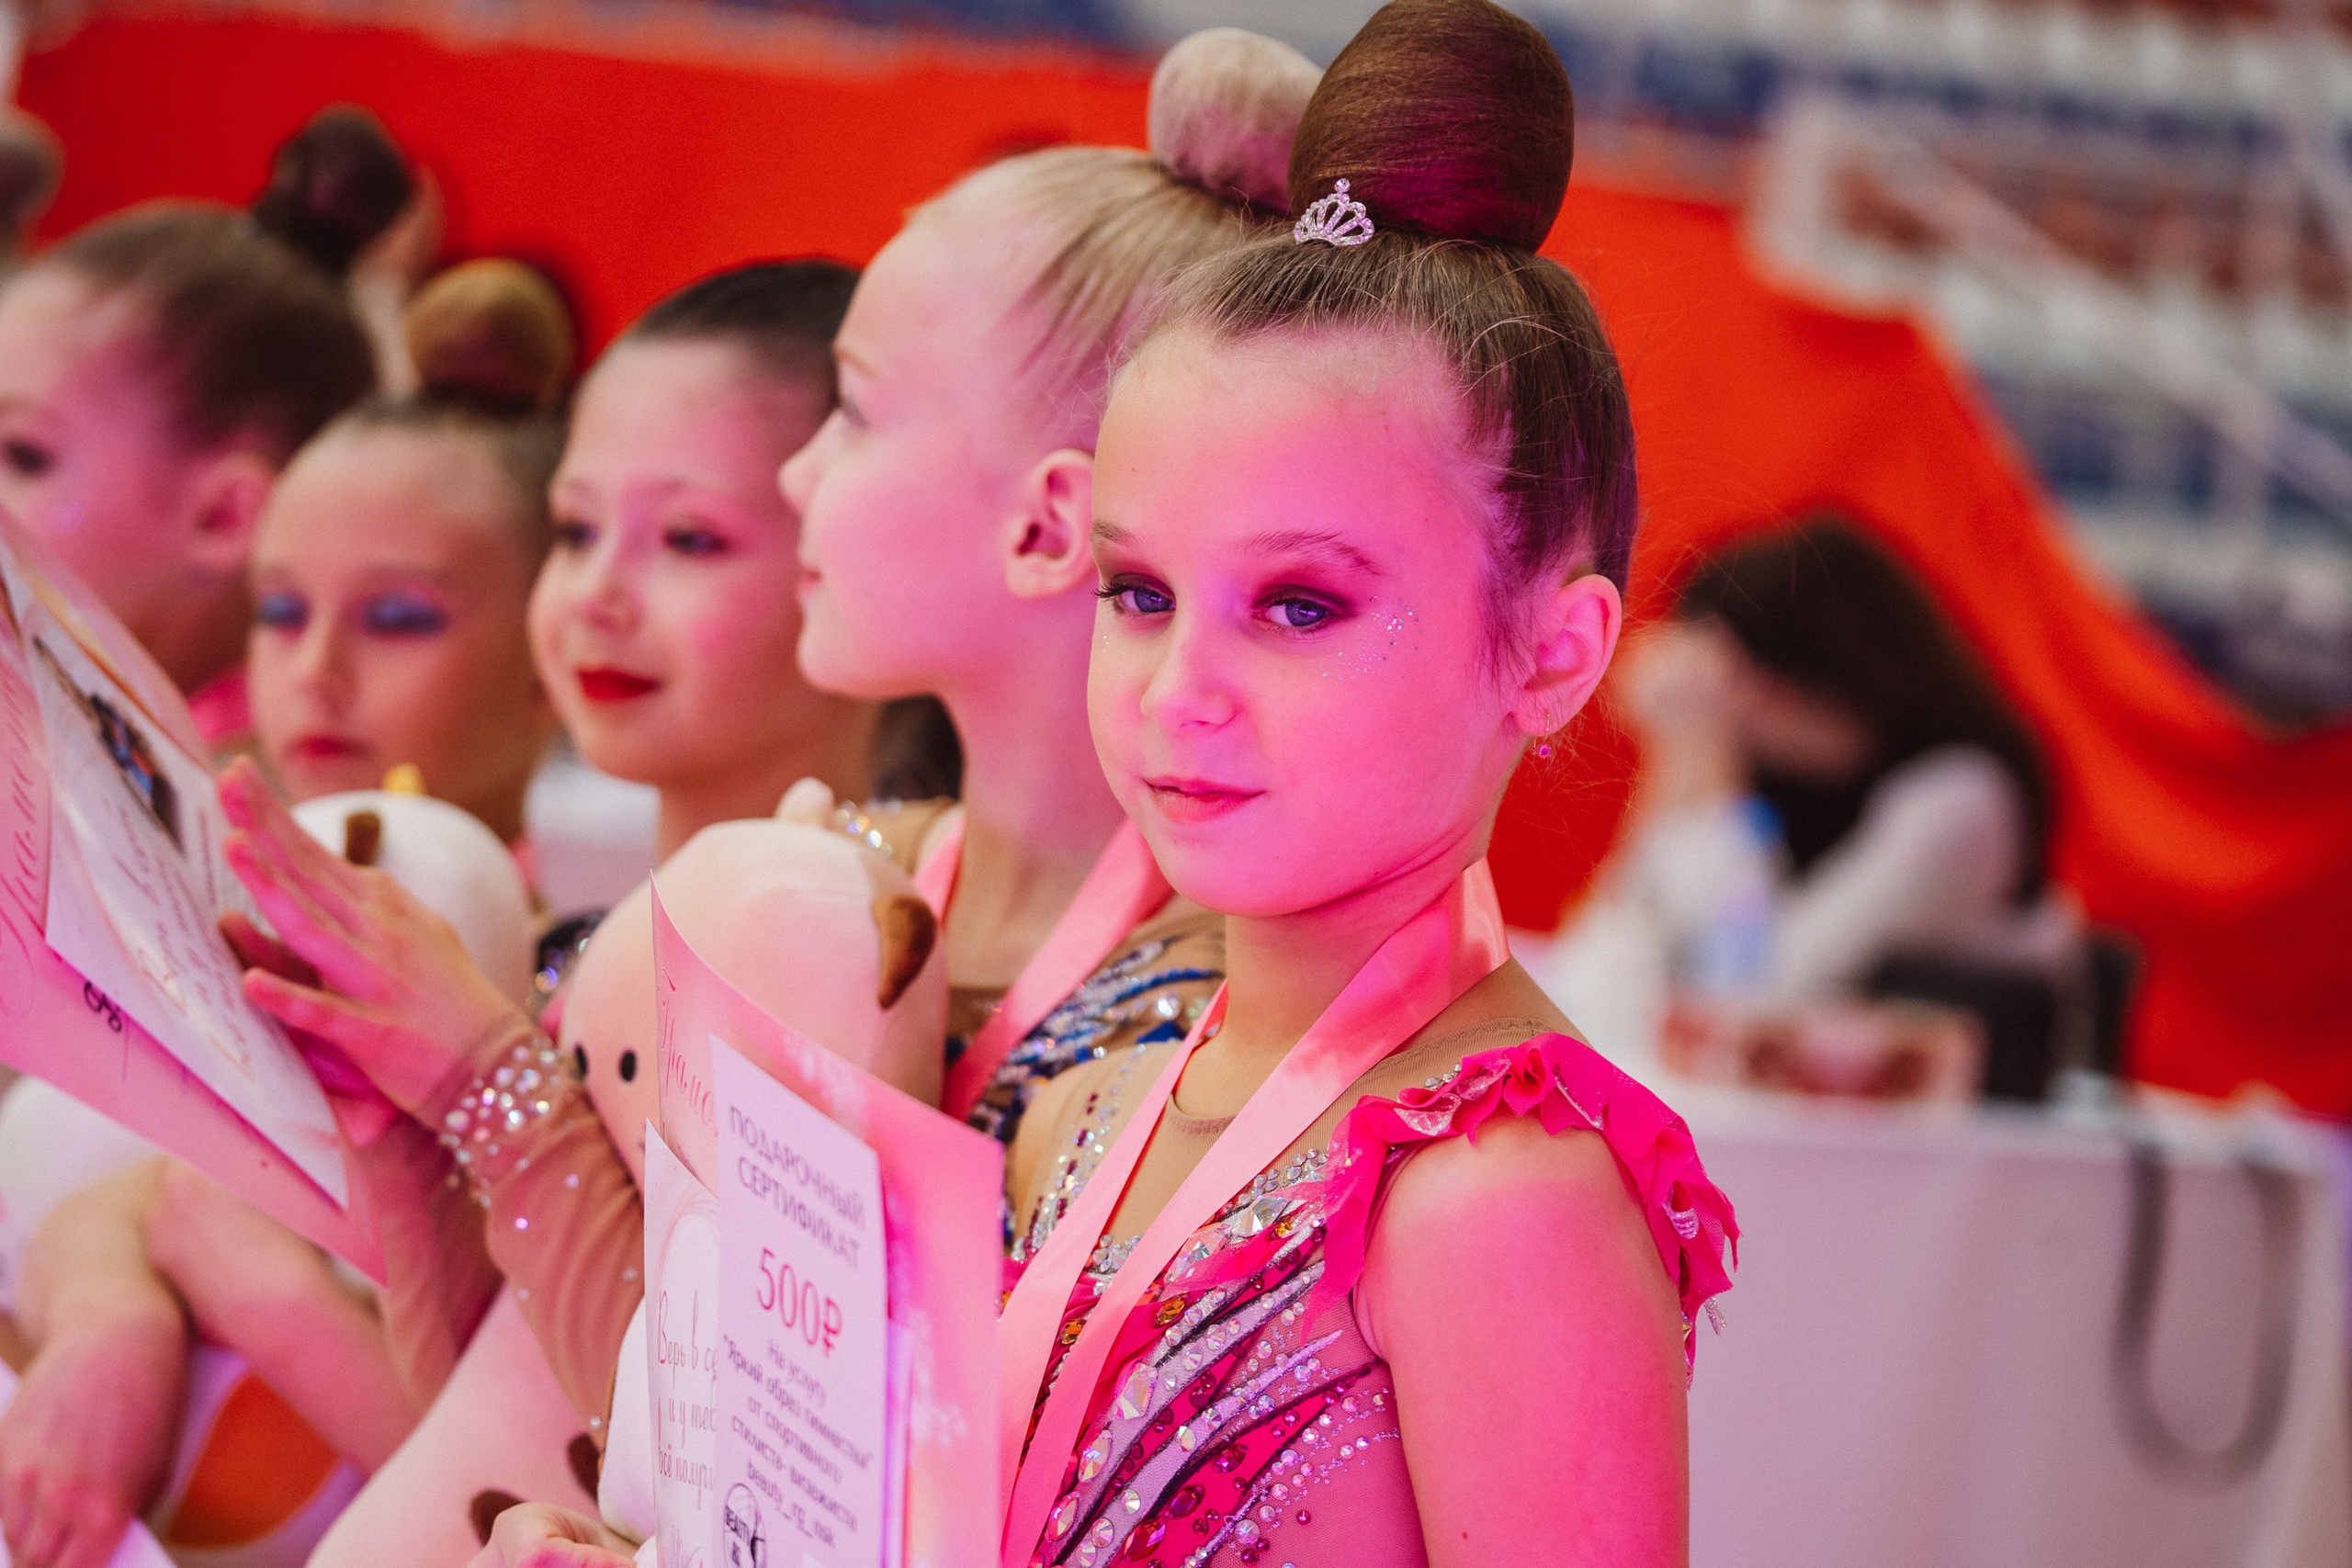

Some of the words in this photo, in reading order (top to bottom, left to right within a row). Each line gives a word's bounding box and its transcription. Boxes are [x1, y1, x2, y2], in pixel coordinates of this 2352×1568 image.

[729, 1105, 866, 1229] ПОДАРОЧНЫЙ
[738, 1156, 859, 1269] СЕРТИФИКАТ
[657, 1290, 686, 1389] Верь
[705, 1347, 717, 1373] се
[769, 1339, 786, 1371] На
[787, 1360, 826, 1410] услугу
[747, 1395, 763, 1417] от
[765, 1411, 843, 1484] спортивного
[766, 1376, 802, 1419] образ
